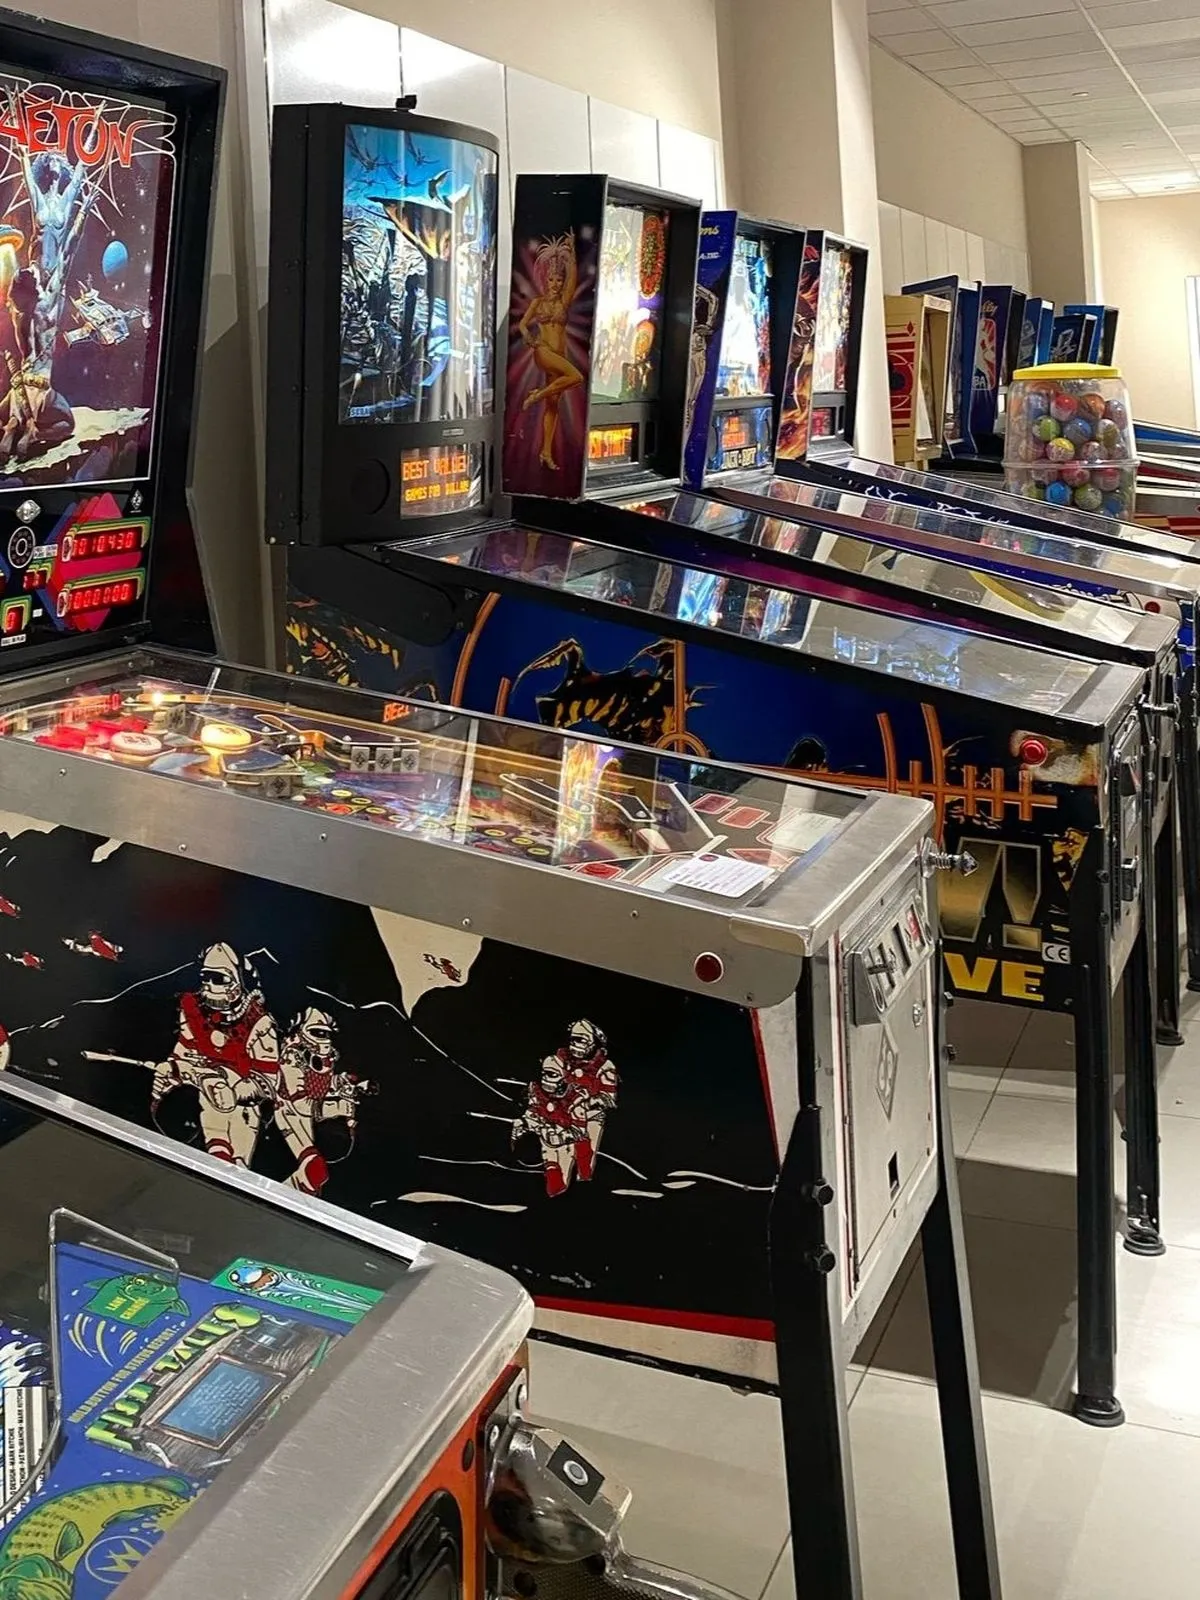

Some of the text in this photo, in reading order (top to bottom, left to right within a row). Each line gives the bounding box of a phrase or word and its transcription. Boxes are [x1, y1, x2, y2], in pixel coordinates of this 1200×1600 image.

[402, 460, 430, 481] BEST
[943, 952, 1045, 1002] VE
[1045, 945, 1068, 961] CE
[84, 1380, 119, 1408] BUTTON
[111, 1369, 132, 1383] FOR
[124, 1348, 155, 1371] STATUS
[85, 1381, 156, 1452] FISH
[151, 1303, 262, 1373] TALES
